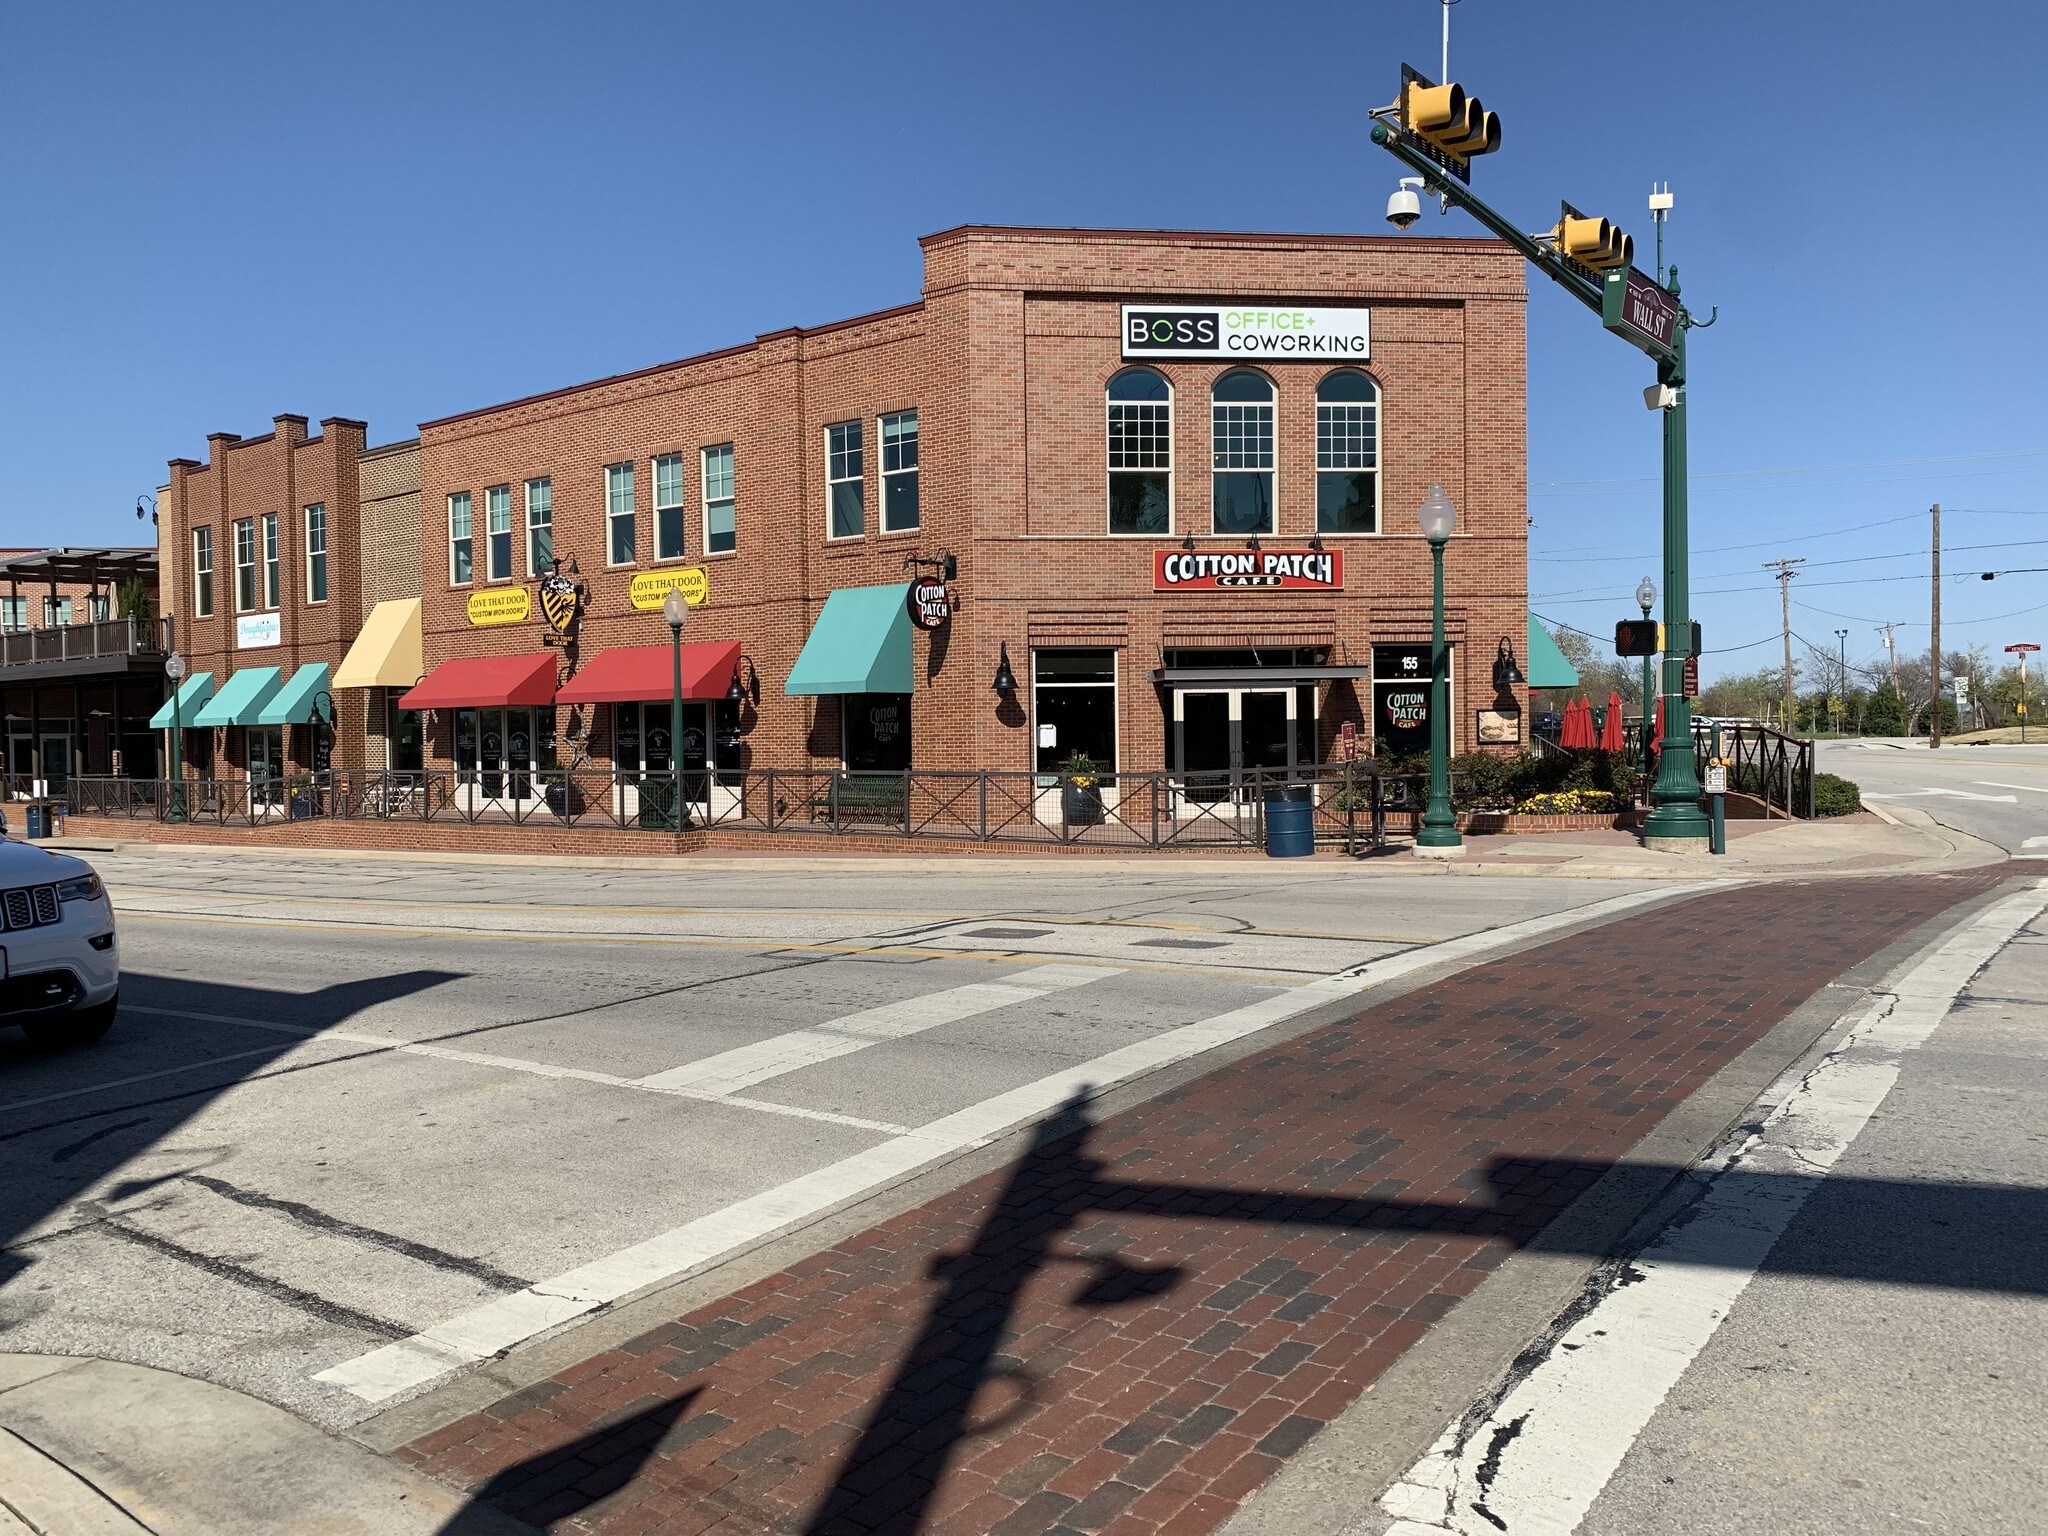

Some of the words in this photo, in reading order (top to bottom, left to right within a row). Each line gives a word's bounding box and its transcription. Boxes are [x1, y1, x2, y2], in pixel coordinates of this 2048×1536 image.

[1225, 312, 1316, 330] OFFICE+
[1633, 299, 1653, 332] WALL
[1653, 314, 1667, 338] ST
[1130, 319, 1215, 343] BOSS
[1227, 334, 1365, 353] COWORKING
[1164, 554, 1255, 583] COTTON
[1264, 554, 1333, 584] PATCH
[633, 581, 654, 591] LOVE
[655, 578, 677, 589] THAT
[678, 576, 703, 587] DOOR
[1222, 577, 1275, 585] CAFE
[470, 599, 487, 608] LOVE
[488, 597, 505, 606] THAT
[506, 595, 526, 605] DOOR
[915, 584, 945, 605] COTTON
[493, 608, 505, 616] IRON
[921, 602, 948, 623] PATCH
[926, 618, 941, 626] CAFE
[1401, 656, 1418, 670] 155
[1387, 691, 1425, 710] COTTON
[870, 706, 898, 724] COTTON
[1392, 707, 1427, 725] PATCH
[874, 722, 899, 739] PATCH
[1398, 721, 1417, 729] CAFE
